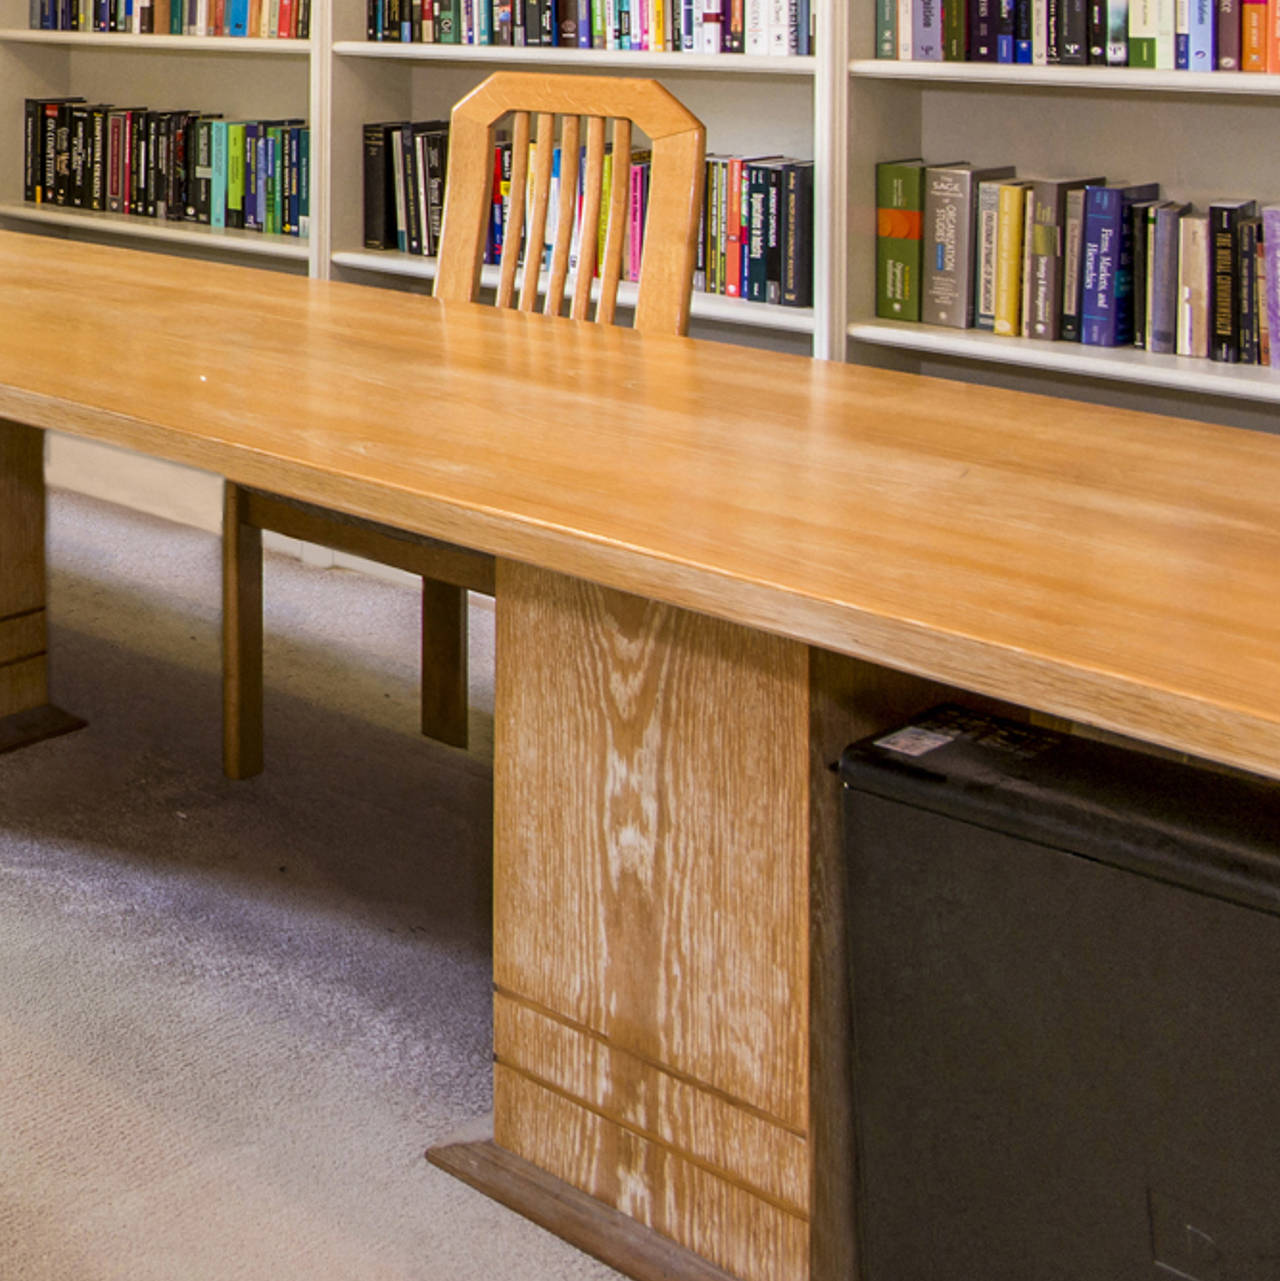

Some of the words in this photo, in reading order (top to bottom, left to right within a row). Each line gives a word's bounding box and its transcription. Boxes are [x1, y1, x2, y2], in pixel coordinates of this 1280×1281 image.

[936, 208, 946, 242] STUDIES
[944, 204, 957, 271] ORGANIZATION
[1098, 228, 1114, 255] Firms,
[1085, 242, 1100, 289] Hierarchies
[1096, 256, 1113, 291] Markets,
[1036, 286, 1047, 321] Management
[1097, 292, 1109, 308] and
